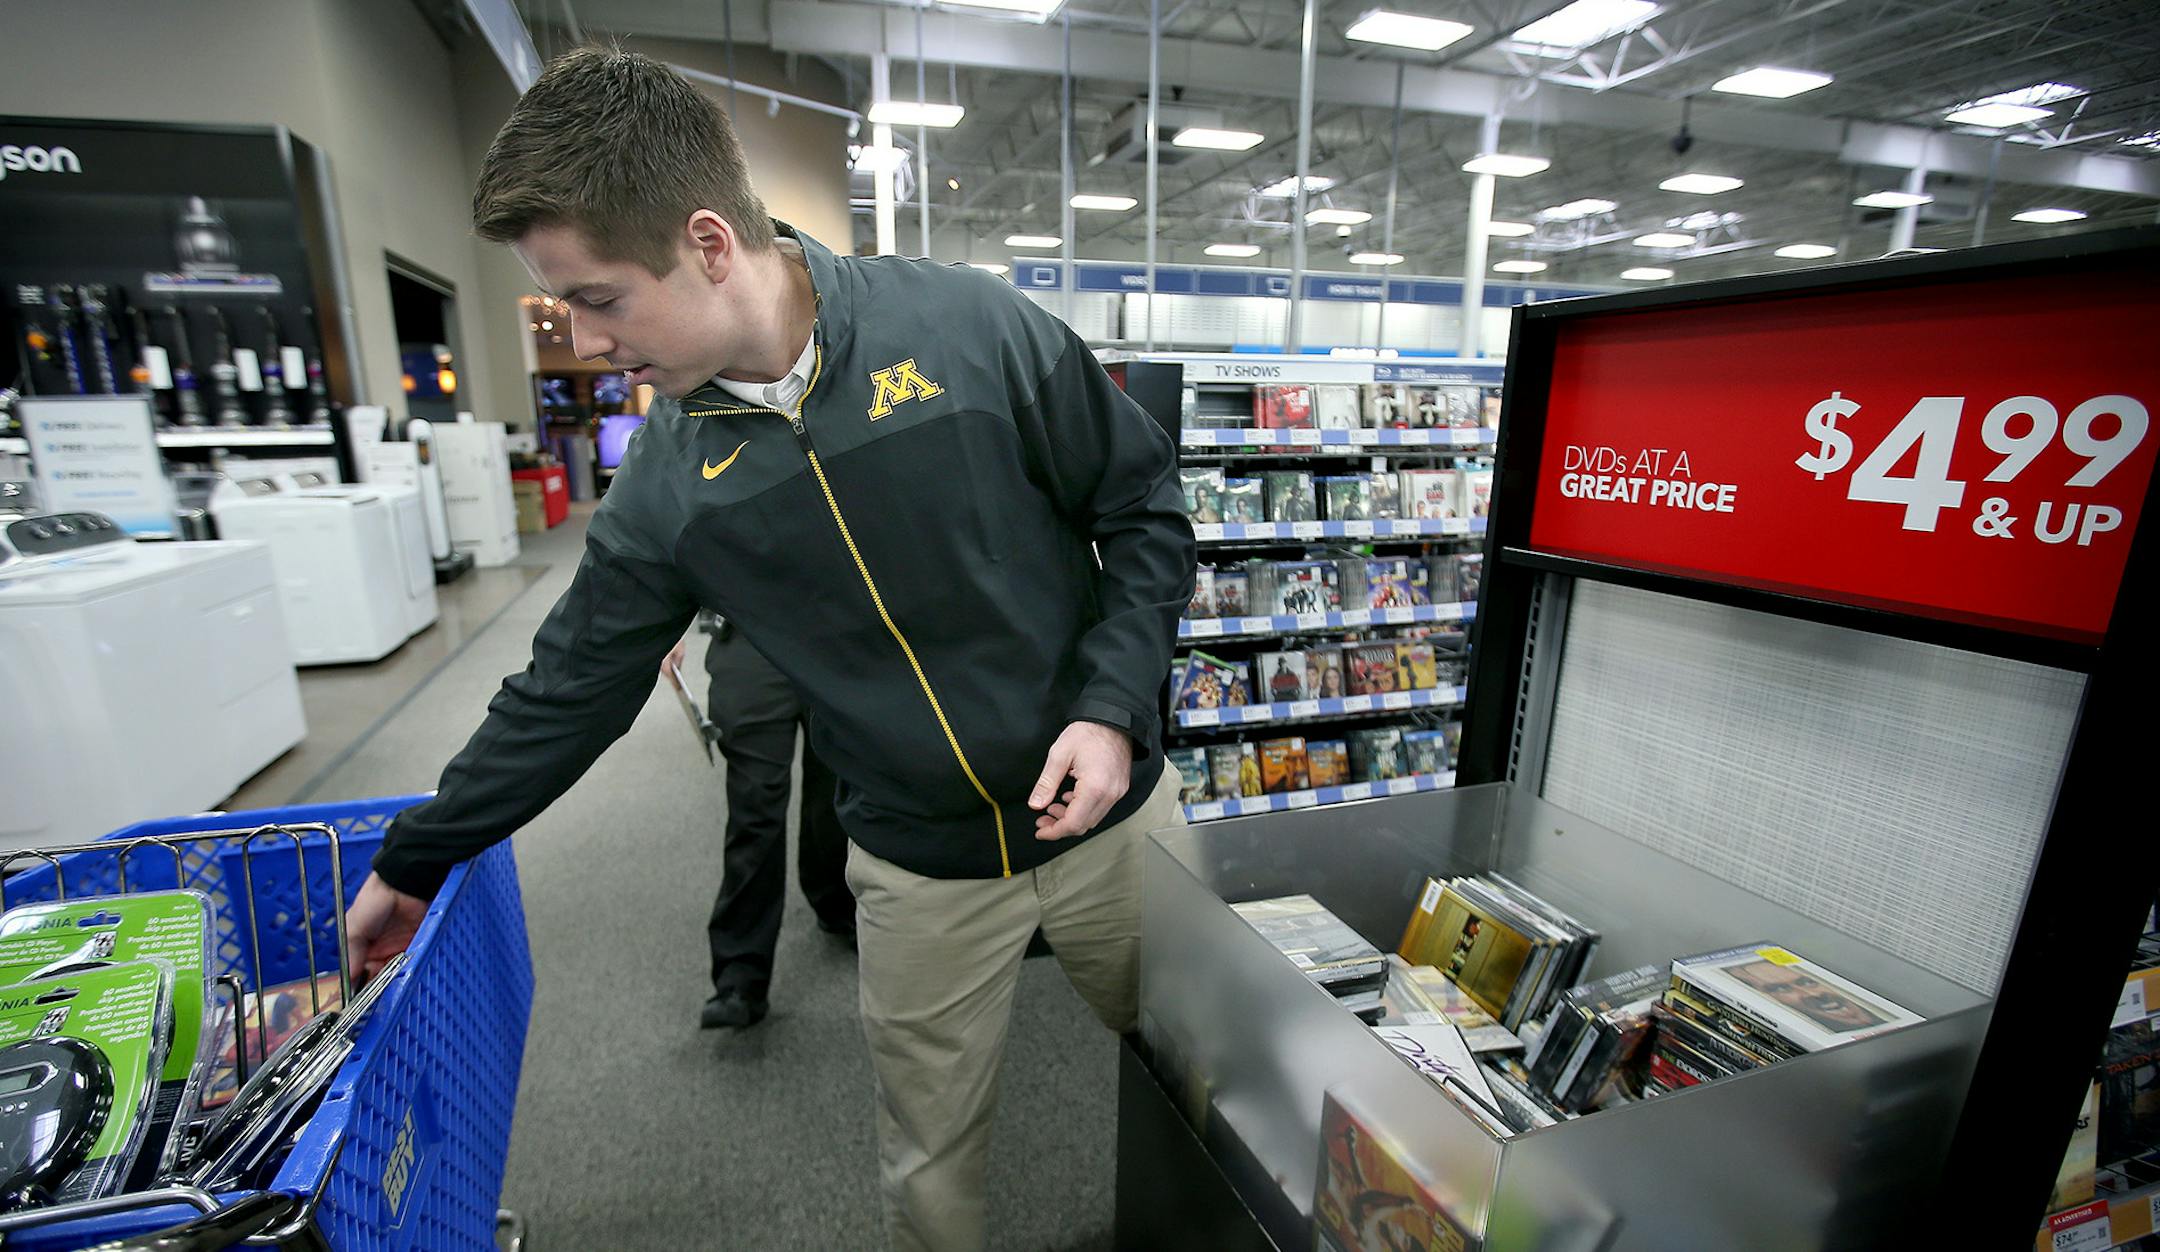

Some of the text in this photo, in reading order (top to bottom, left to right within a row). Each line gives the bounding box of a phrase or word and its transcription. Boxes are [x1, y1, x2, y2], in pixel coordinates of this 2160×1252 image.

[1215, 365, 1281, 377] TV SHOWS
[1564, 445, 1692, 478] DVDs AT A
[1560, 473, 1738, 513] GREAT PRICE
[1972, 497, 2123, 546] & UP
[180, 1135, 197, 1168] JVC
[382, 1104, 414, 1196] BEST
[388, 1127, 415, 1217] BUY
